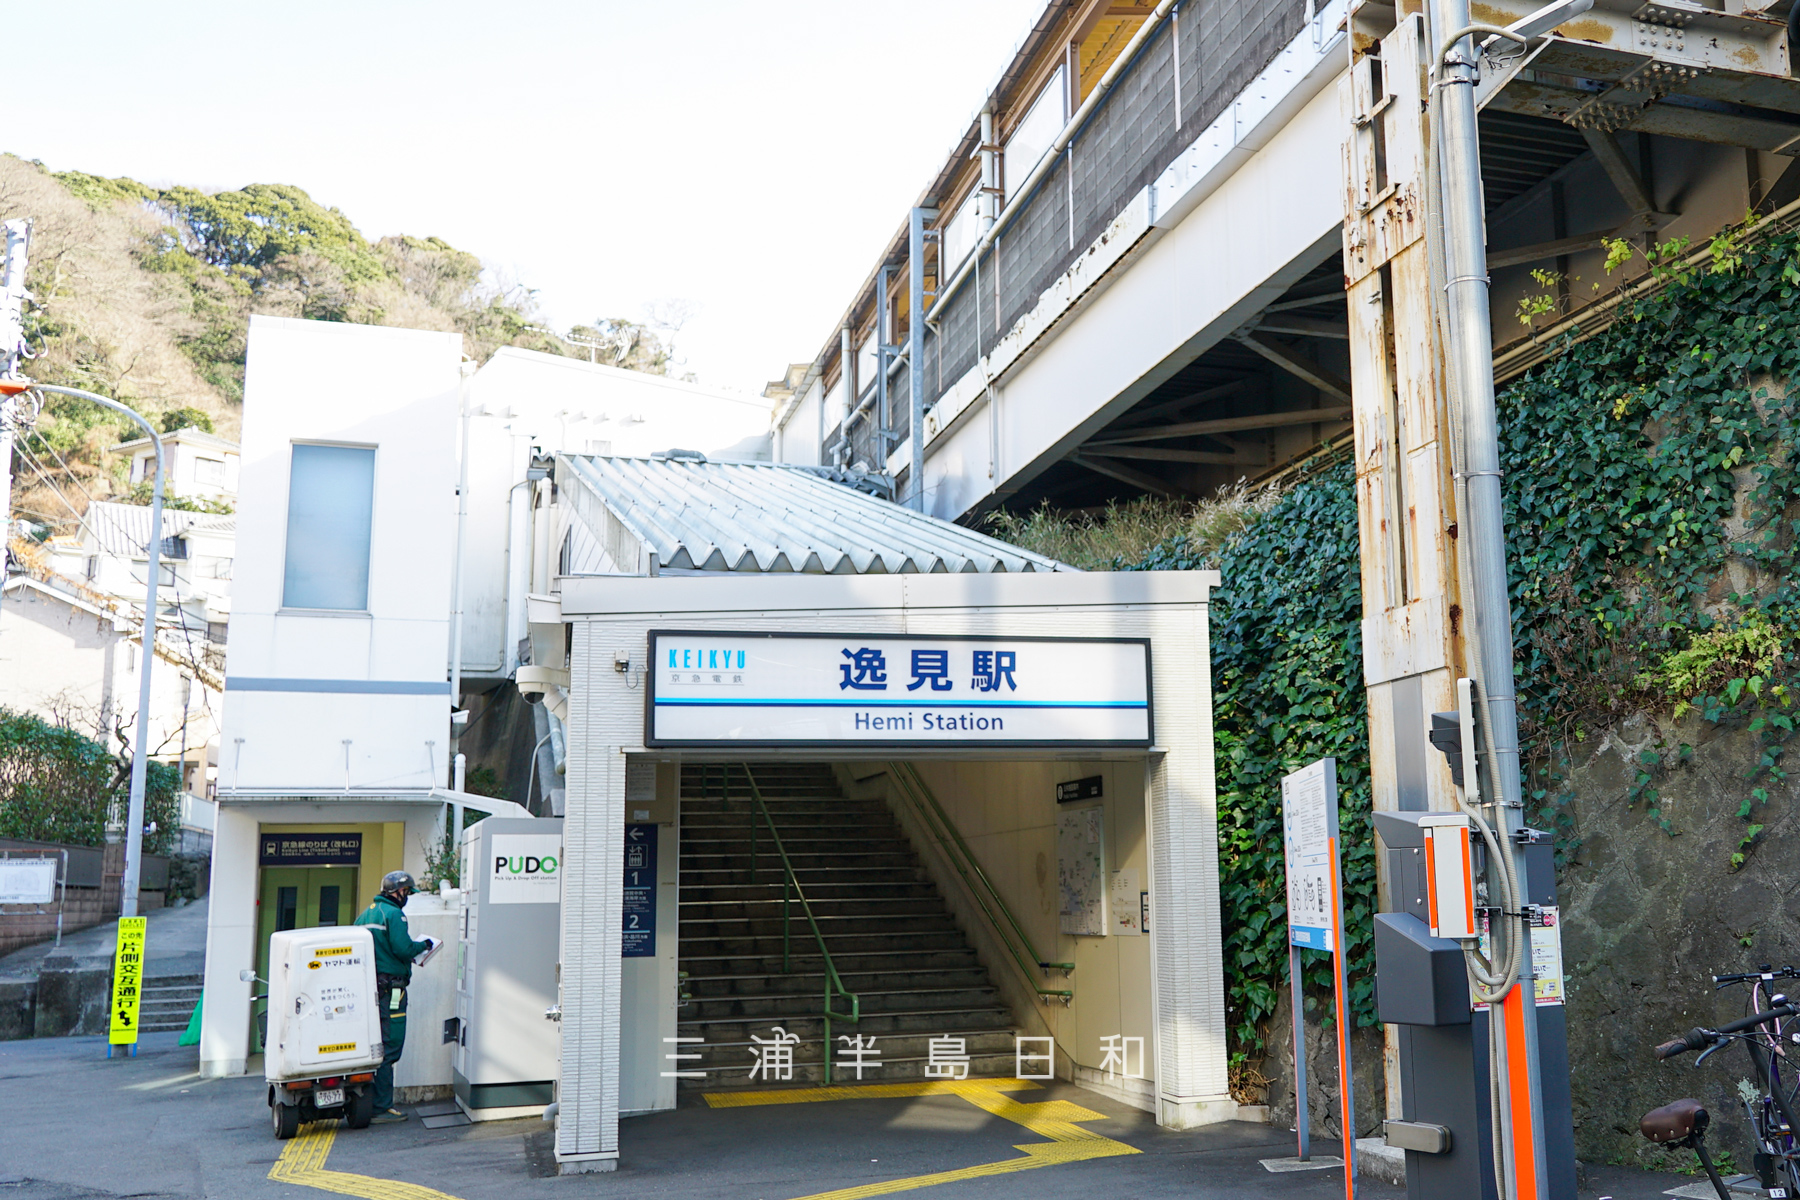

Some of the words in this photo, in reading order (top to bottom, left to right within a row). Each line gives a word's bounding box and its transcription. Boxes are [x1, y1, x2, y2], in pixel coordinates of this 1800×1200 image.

[668, 648, 747, 670] KEIKYU
[671, 673, 743, 684] 京急電鉄
[839, 648, 1018, 693] 逸見駅
[855, 711, 914, 731] Hemi
[922, 711, 1004, 731] Station
[495, 855, 558, 874] PUDO
[631, 871, 638, 885] 1
[629, 914, 639, 929] 2
[121, 932, 142, 940] この先
[324, 958, 360, 967] ヤマト運輸
[117, 942, 140, 1008] 片側交互通行
